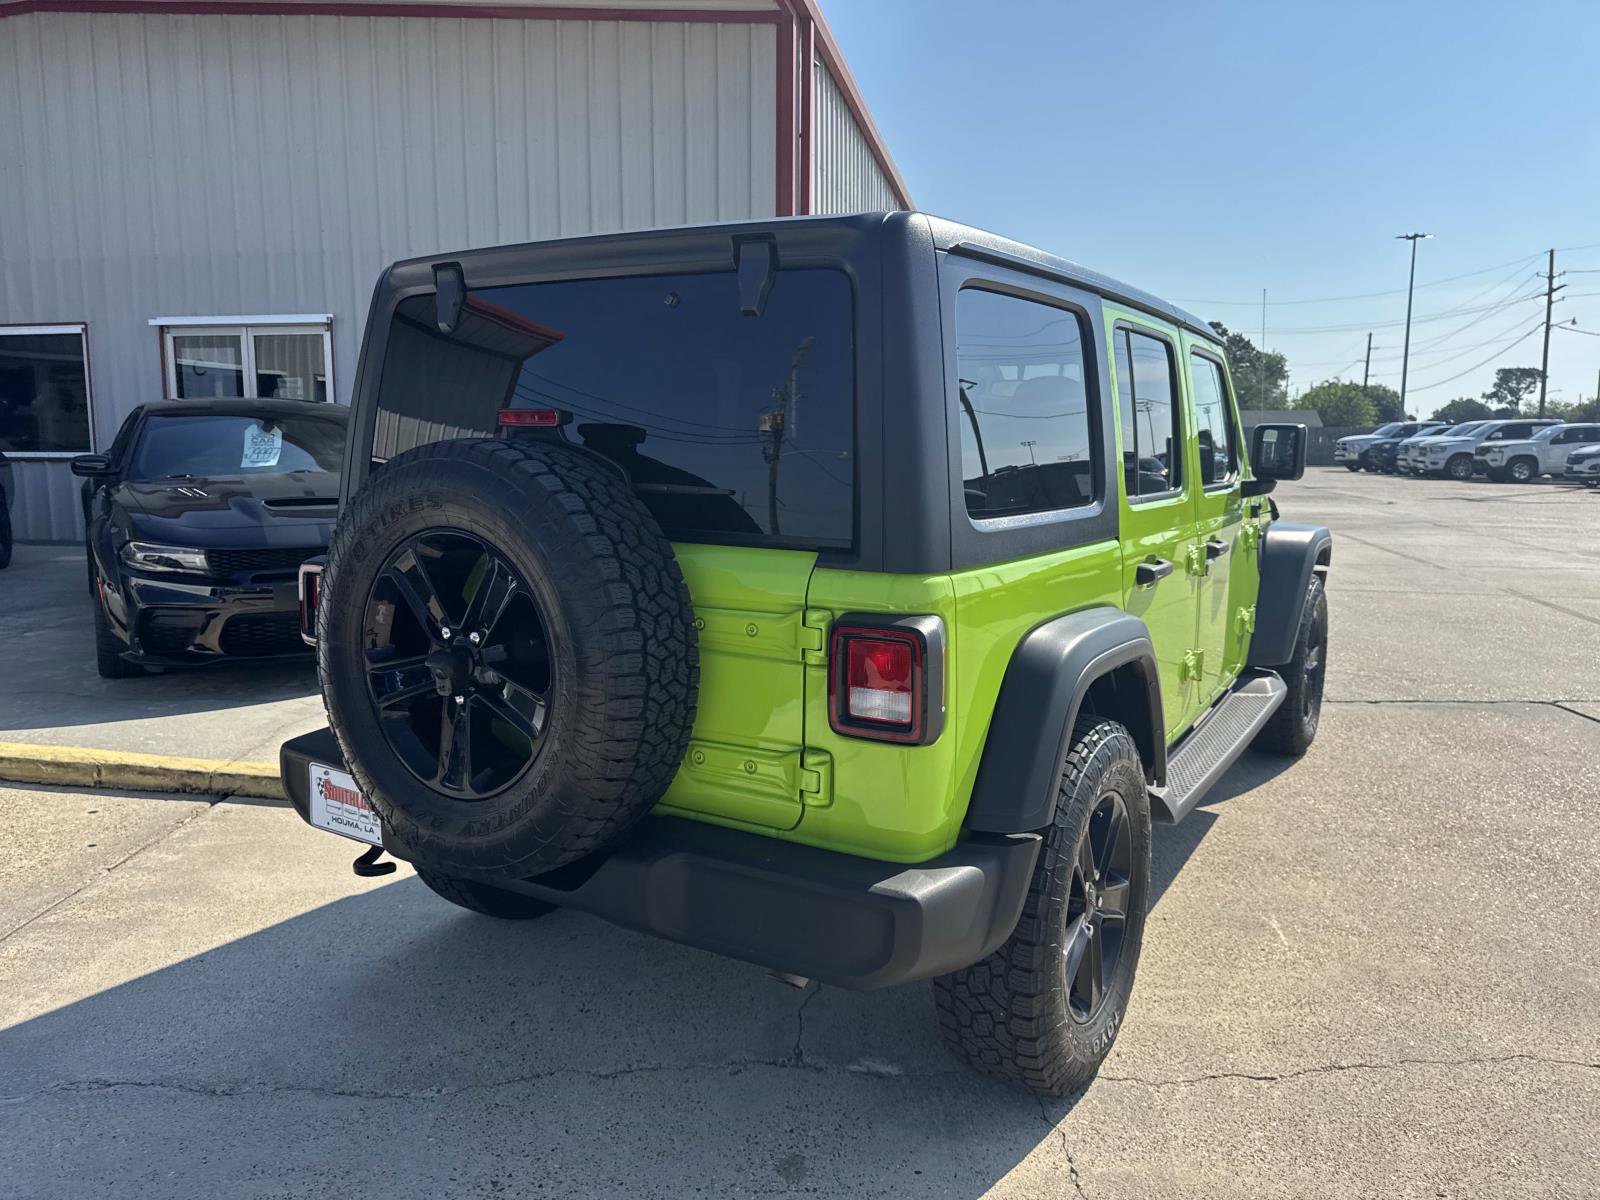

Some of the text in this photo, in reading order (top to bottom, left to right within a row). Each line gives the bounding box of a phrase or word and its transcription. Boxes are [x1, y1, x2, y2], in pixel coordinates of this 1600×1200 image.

[324, 779, 370, 810] SOUTHL
[331, 816, 375, 834] HOUMA, LA
